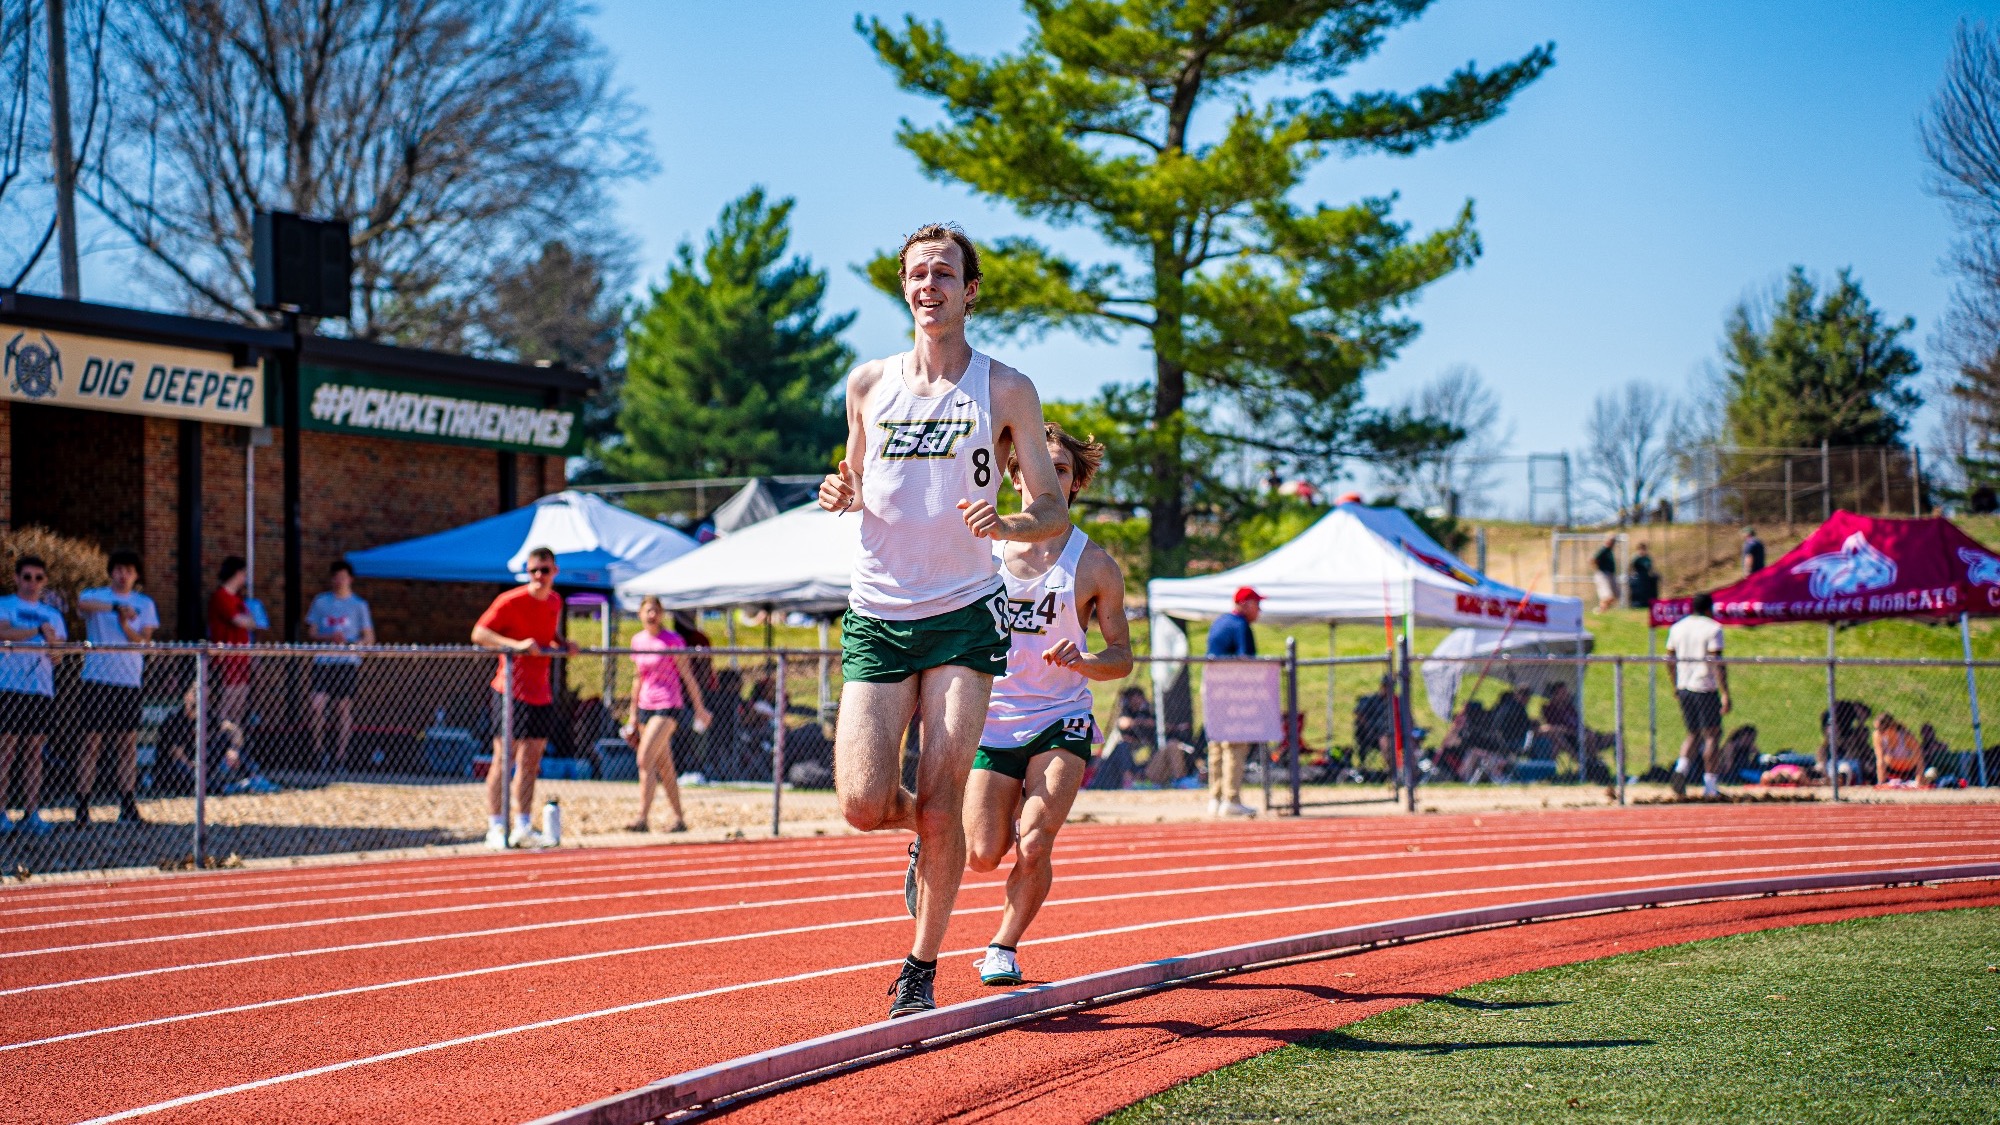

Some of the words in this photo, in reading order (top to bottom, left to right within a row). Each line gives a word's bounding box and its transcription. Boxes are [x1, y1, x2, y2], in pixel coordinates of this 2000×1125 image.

[79, 357, 135, 398] DIG
[143, 364, 255, 412] DEEPER
[310, 382, 575, 449] #PICKAXETAKENAMES
[879, 420, 974, 458] S&T
[971, 447, 991, 488] 8
[1036, 591, 1057, 625] 4
[1868, 586, 1958, 613] BOBCATS
